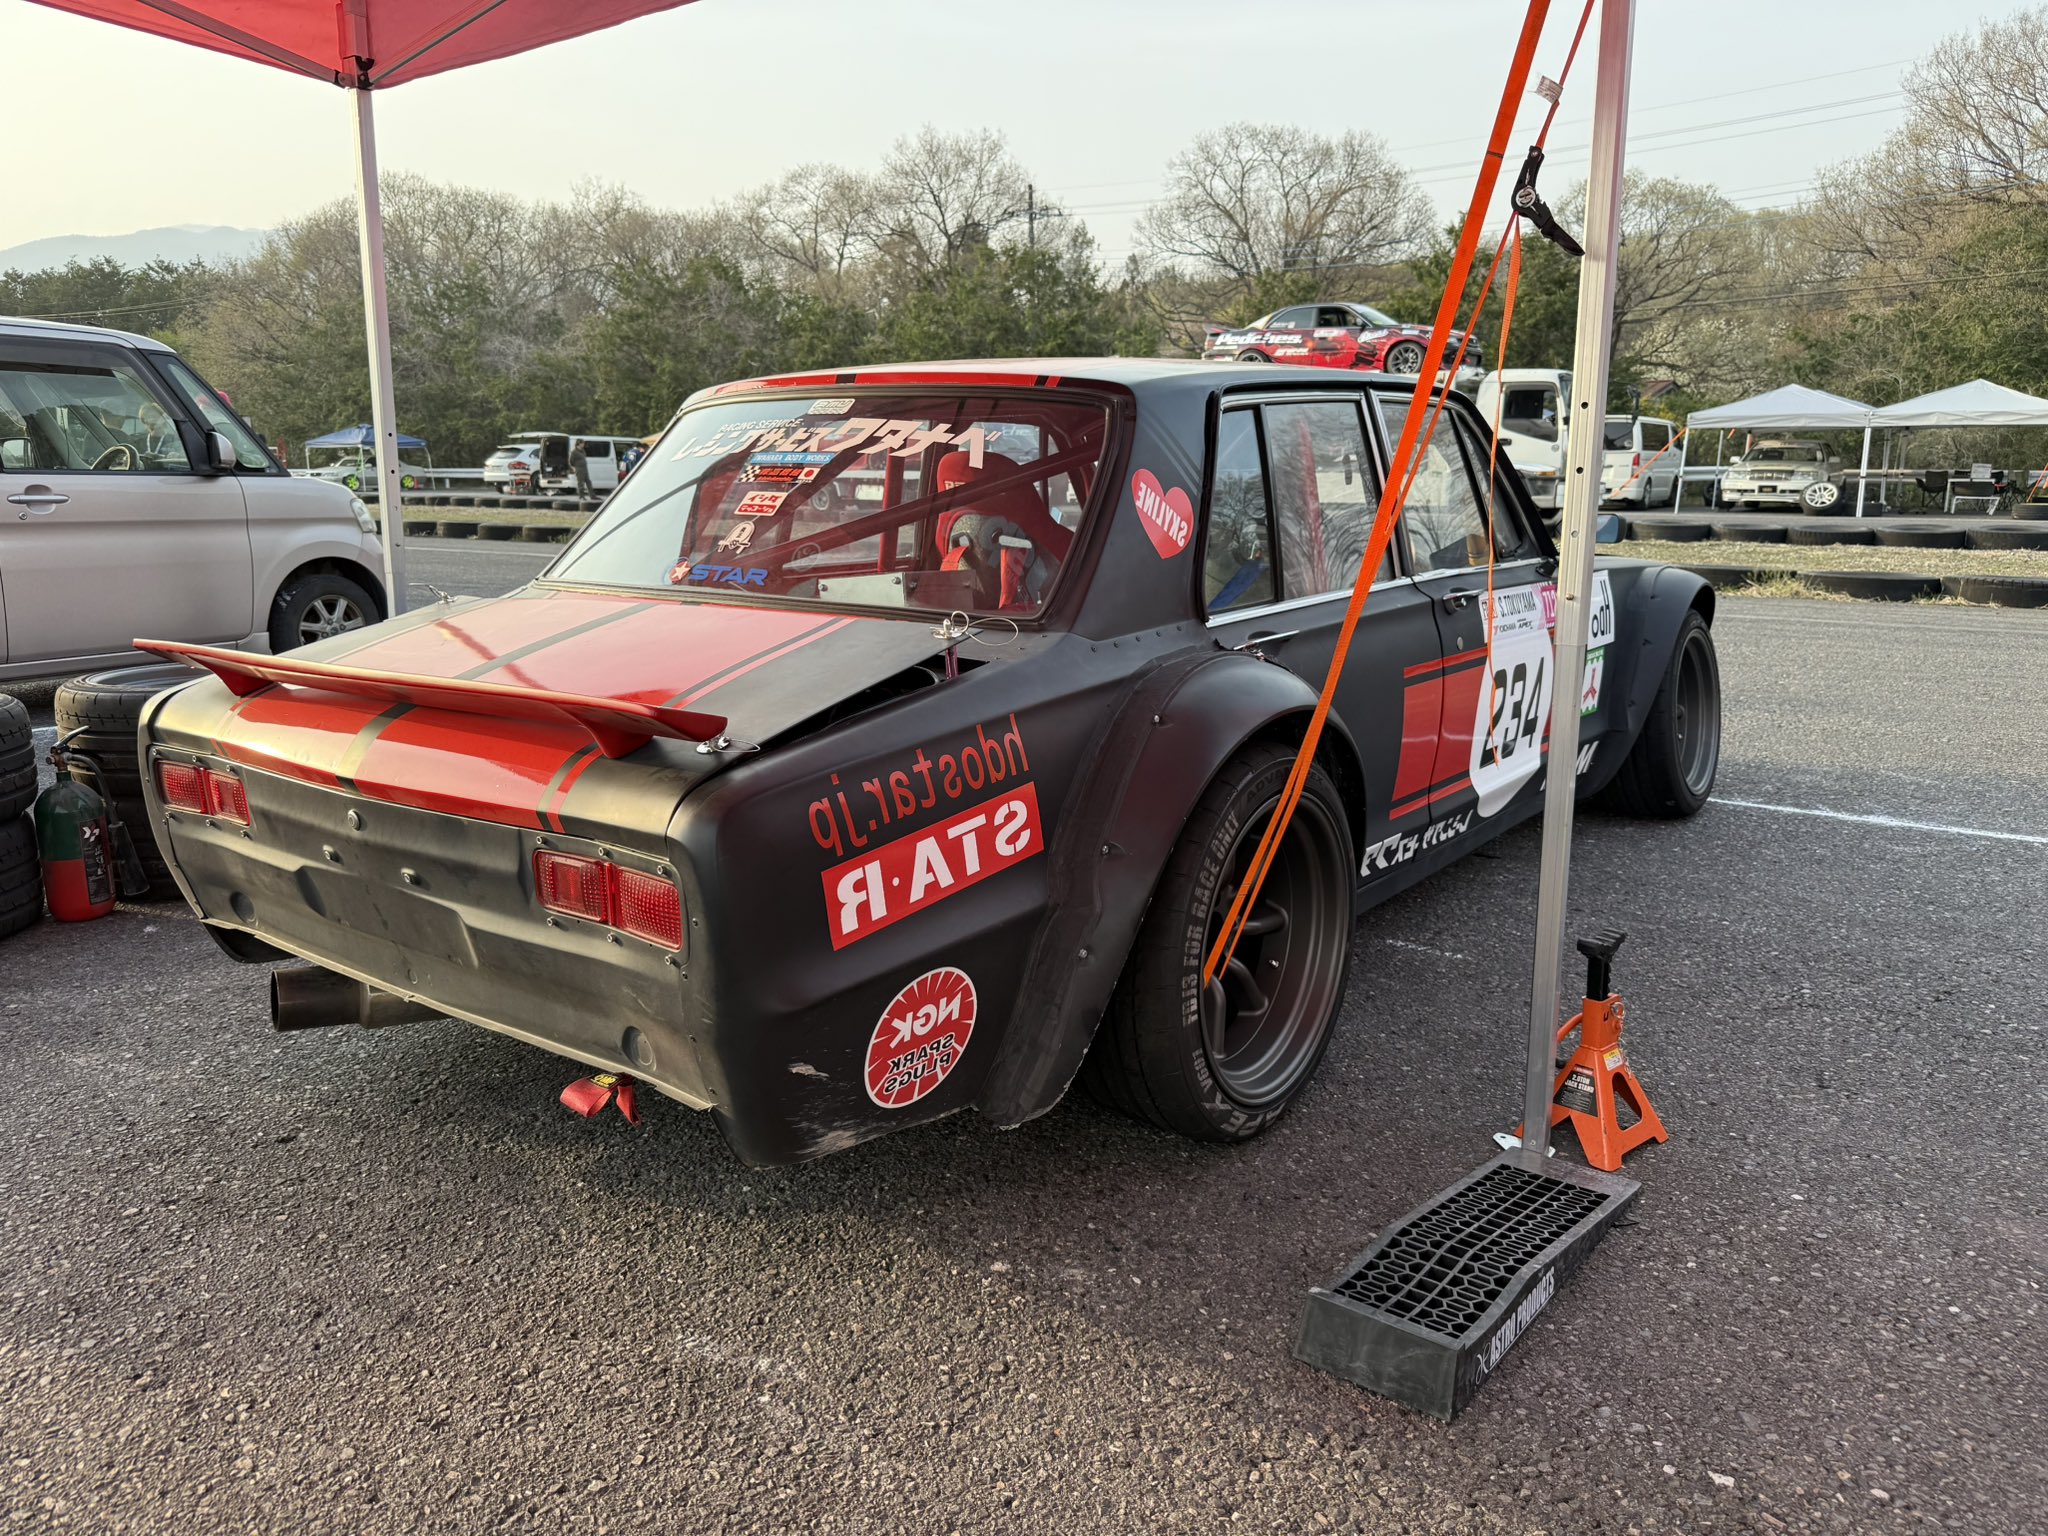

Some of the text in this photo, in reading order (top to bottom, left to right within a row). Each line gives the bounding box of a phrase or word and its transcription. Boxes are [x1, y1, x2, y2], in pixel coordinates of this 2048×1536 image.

[719, 418, 804, 433] RACING SERVICE
[784, 454, 804, 462] BODY
[805, 454, 831, 462] WORKS
[688, 564, 769, 586] STAR
[1479, 656, 1544, 769] 234
[1210, 810, 1239, 860] ONLY
[1192, 856, 1220, 919] RACE
[1184, 924, 1204, 967] FOR
[1564, 1080, 1595, 1093] JACK STAND
[1571, 1074, 1590, 1084] 2.0TON
[1489, 1266, 1555, 1367] ASTRO PRODUCTS
